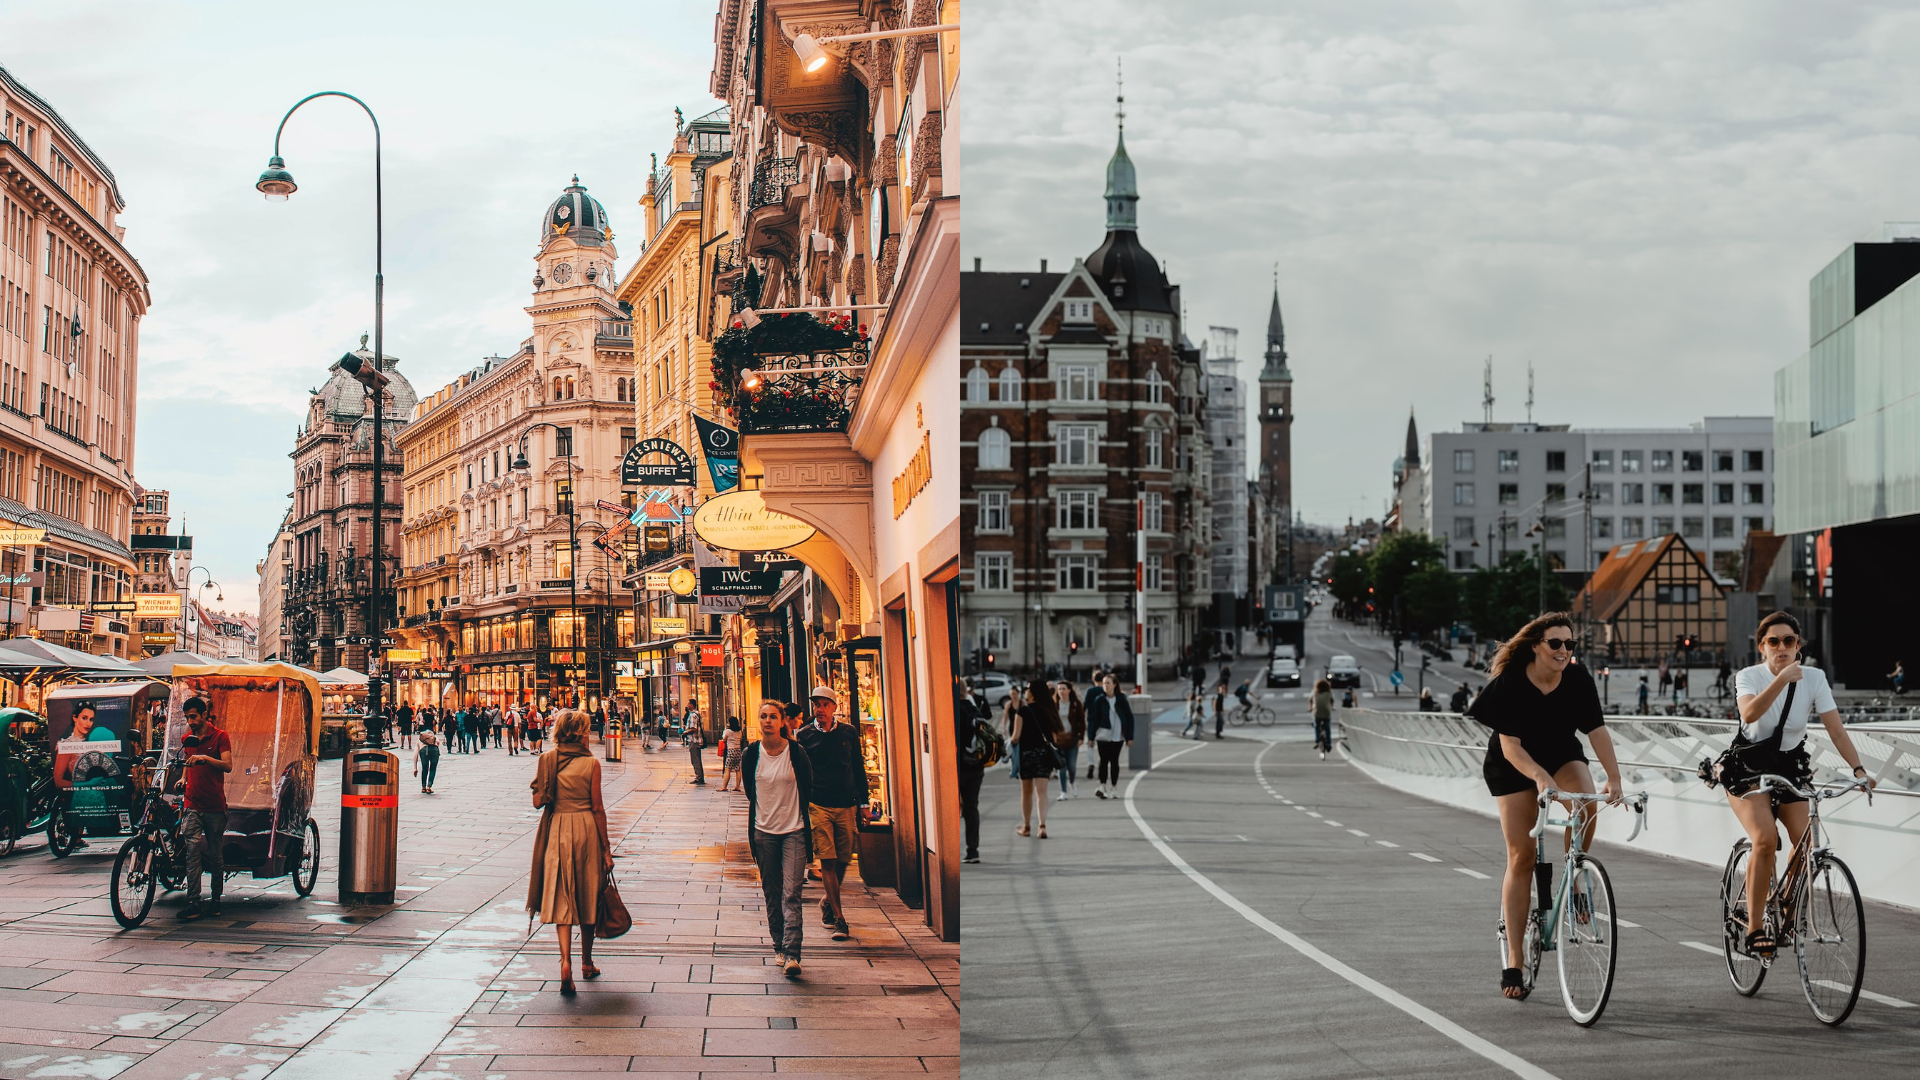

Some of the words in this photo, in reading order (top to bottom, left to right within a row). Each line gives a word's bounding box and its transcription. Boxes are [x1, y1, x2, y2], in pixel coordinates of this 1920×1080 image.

[638, 467, 677, 475] BUFFET
[703, 506, 752, 522] Albin
[754, 554, 790, 562] BALLY
[722, 571, 751, 582] IWC
[701, 597, 743, 607] LISKA
